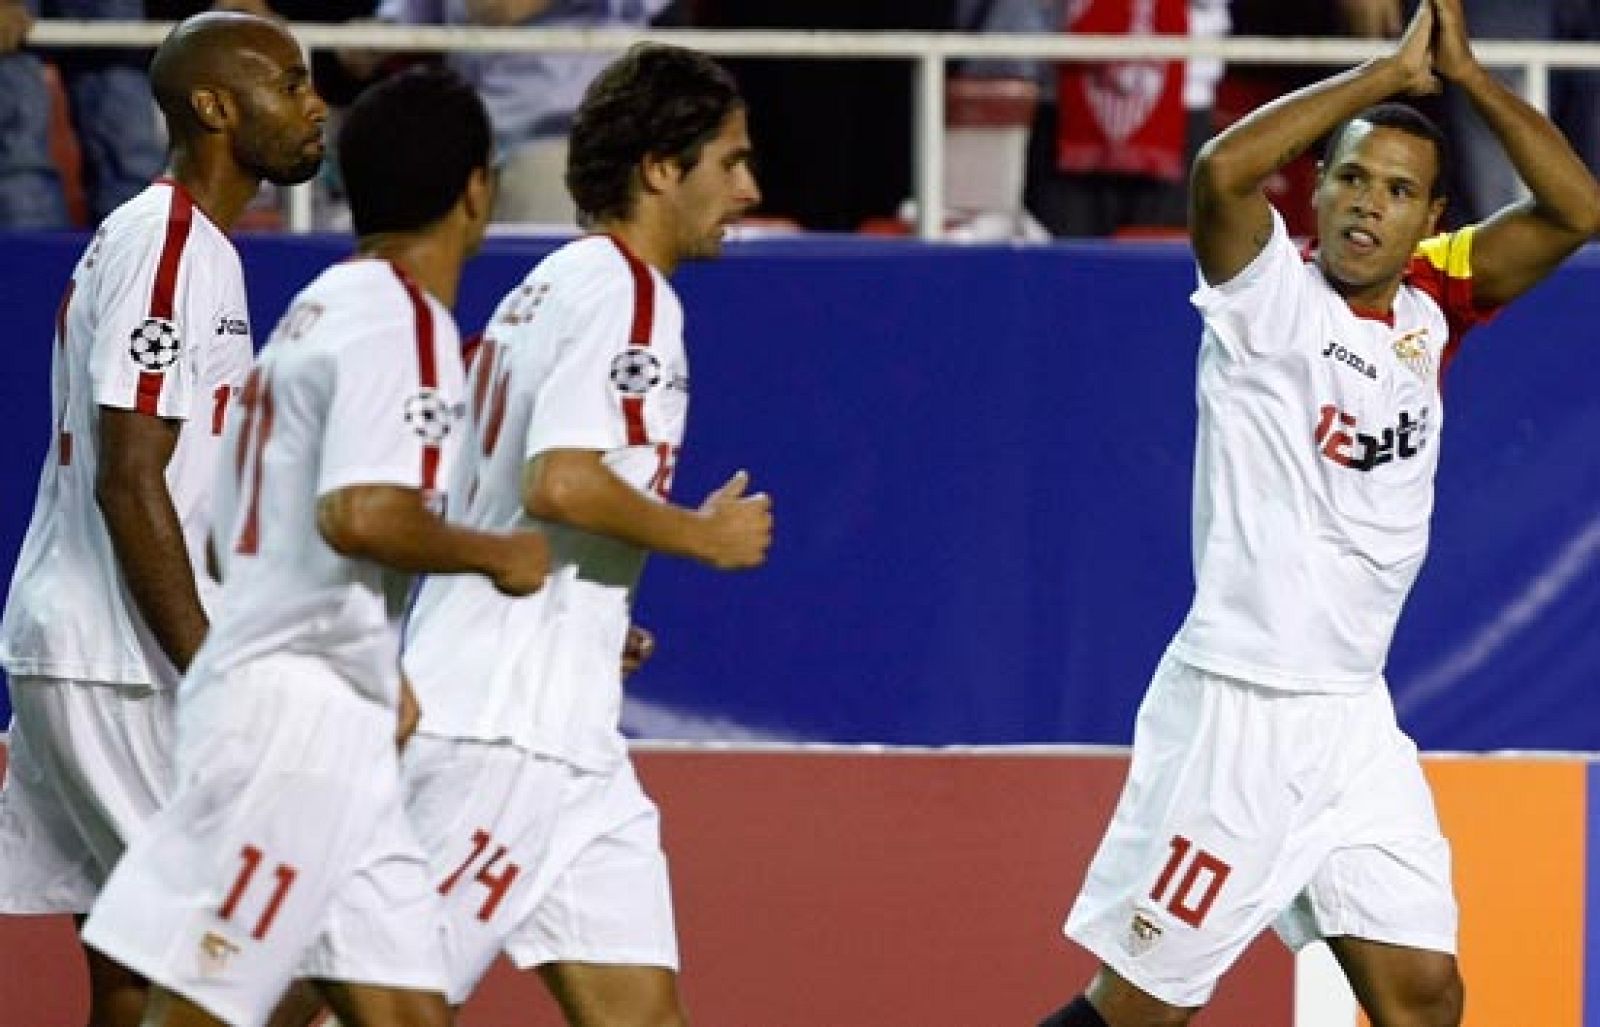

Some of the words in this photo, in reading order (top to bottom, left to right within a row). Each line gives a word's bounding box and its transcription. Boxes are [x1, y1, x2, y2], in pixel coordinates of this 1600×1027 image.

[219, 844, 297, 940] 11
[437, 829, 520, 922] 14
[1149, 834, 1233, 929] 10
